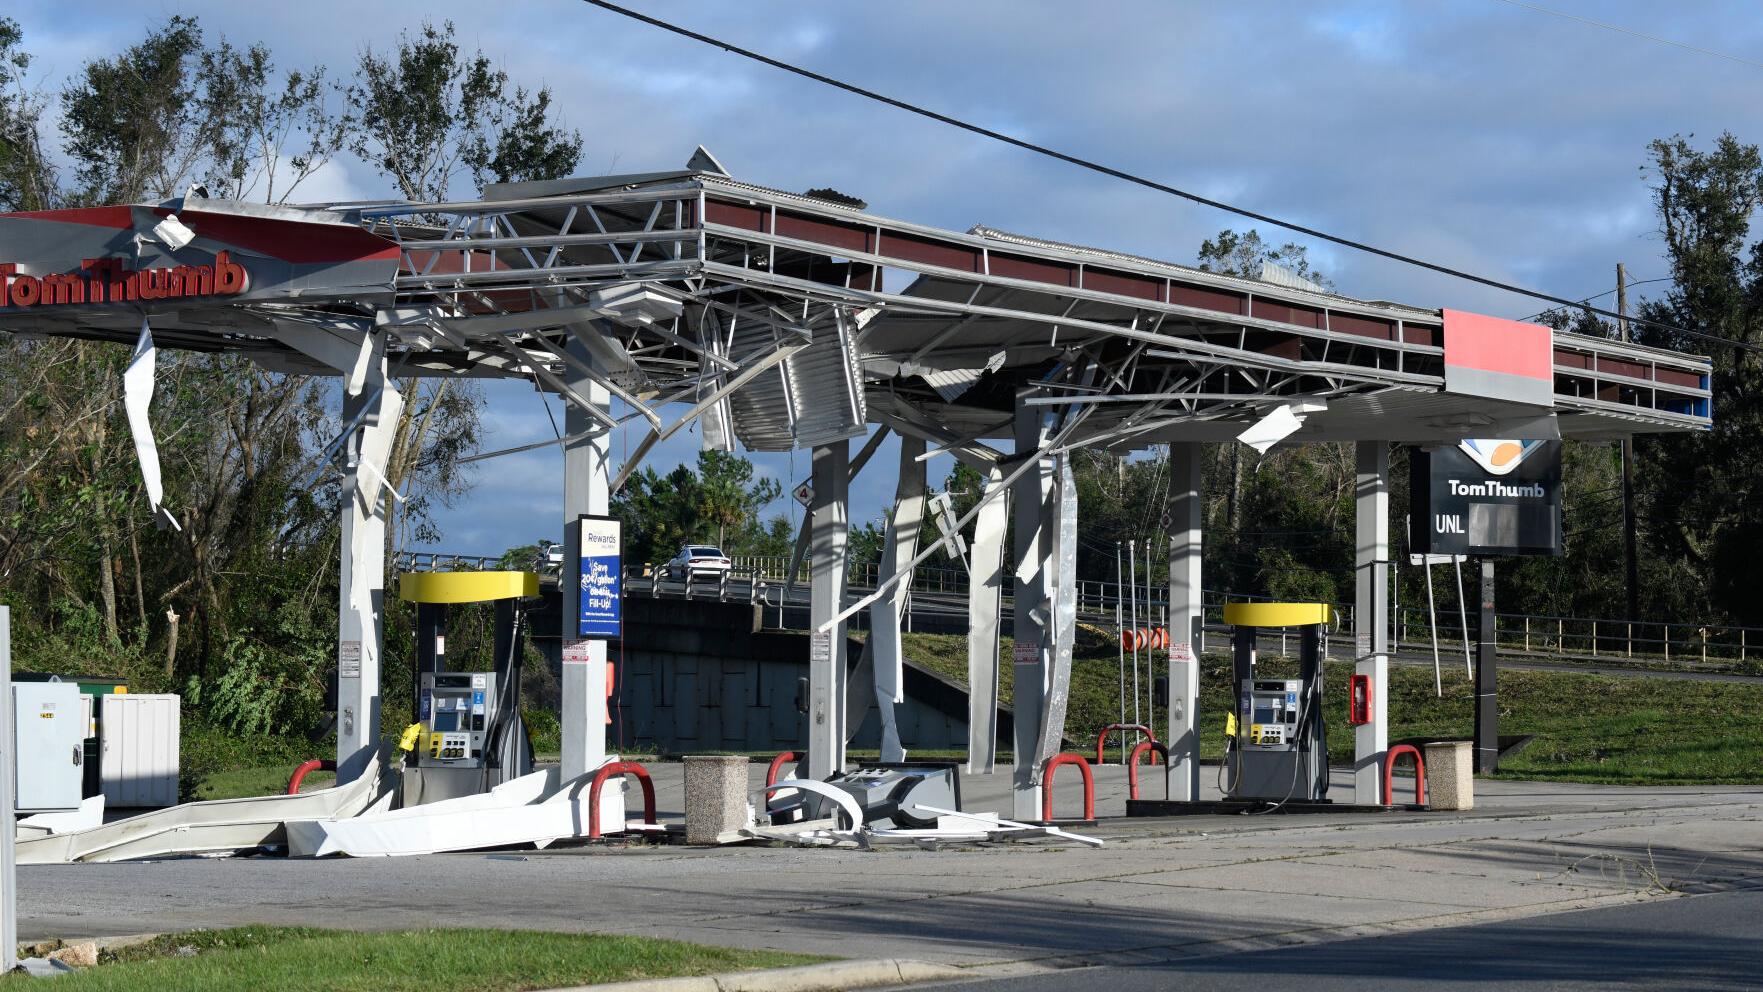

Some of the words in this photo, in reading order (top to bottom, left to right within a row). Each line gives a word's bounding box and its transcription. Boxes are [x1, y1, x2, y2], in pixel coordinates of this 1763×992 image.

[1448, 480, 1544, 498] TomThumb
[1436, 514, 1465, 533] UNL
[588, 532, 616, 544] Rewards
